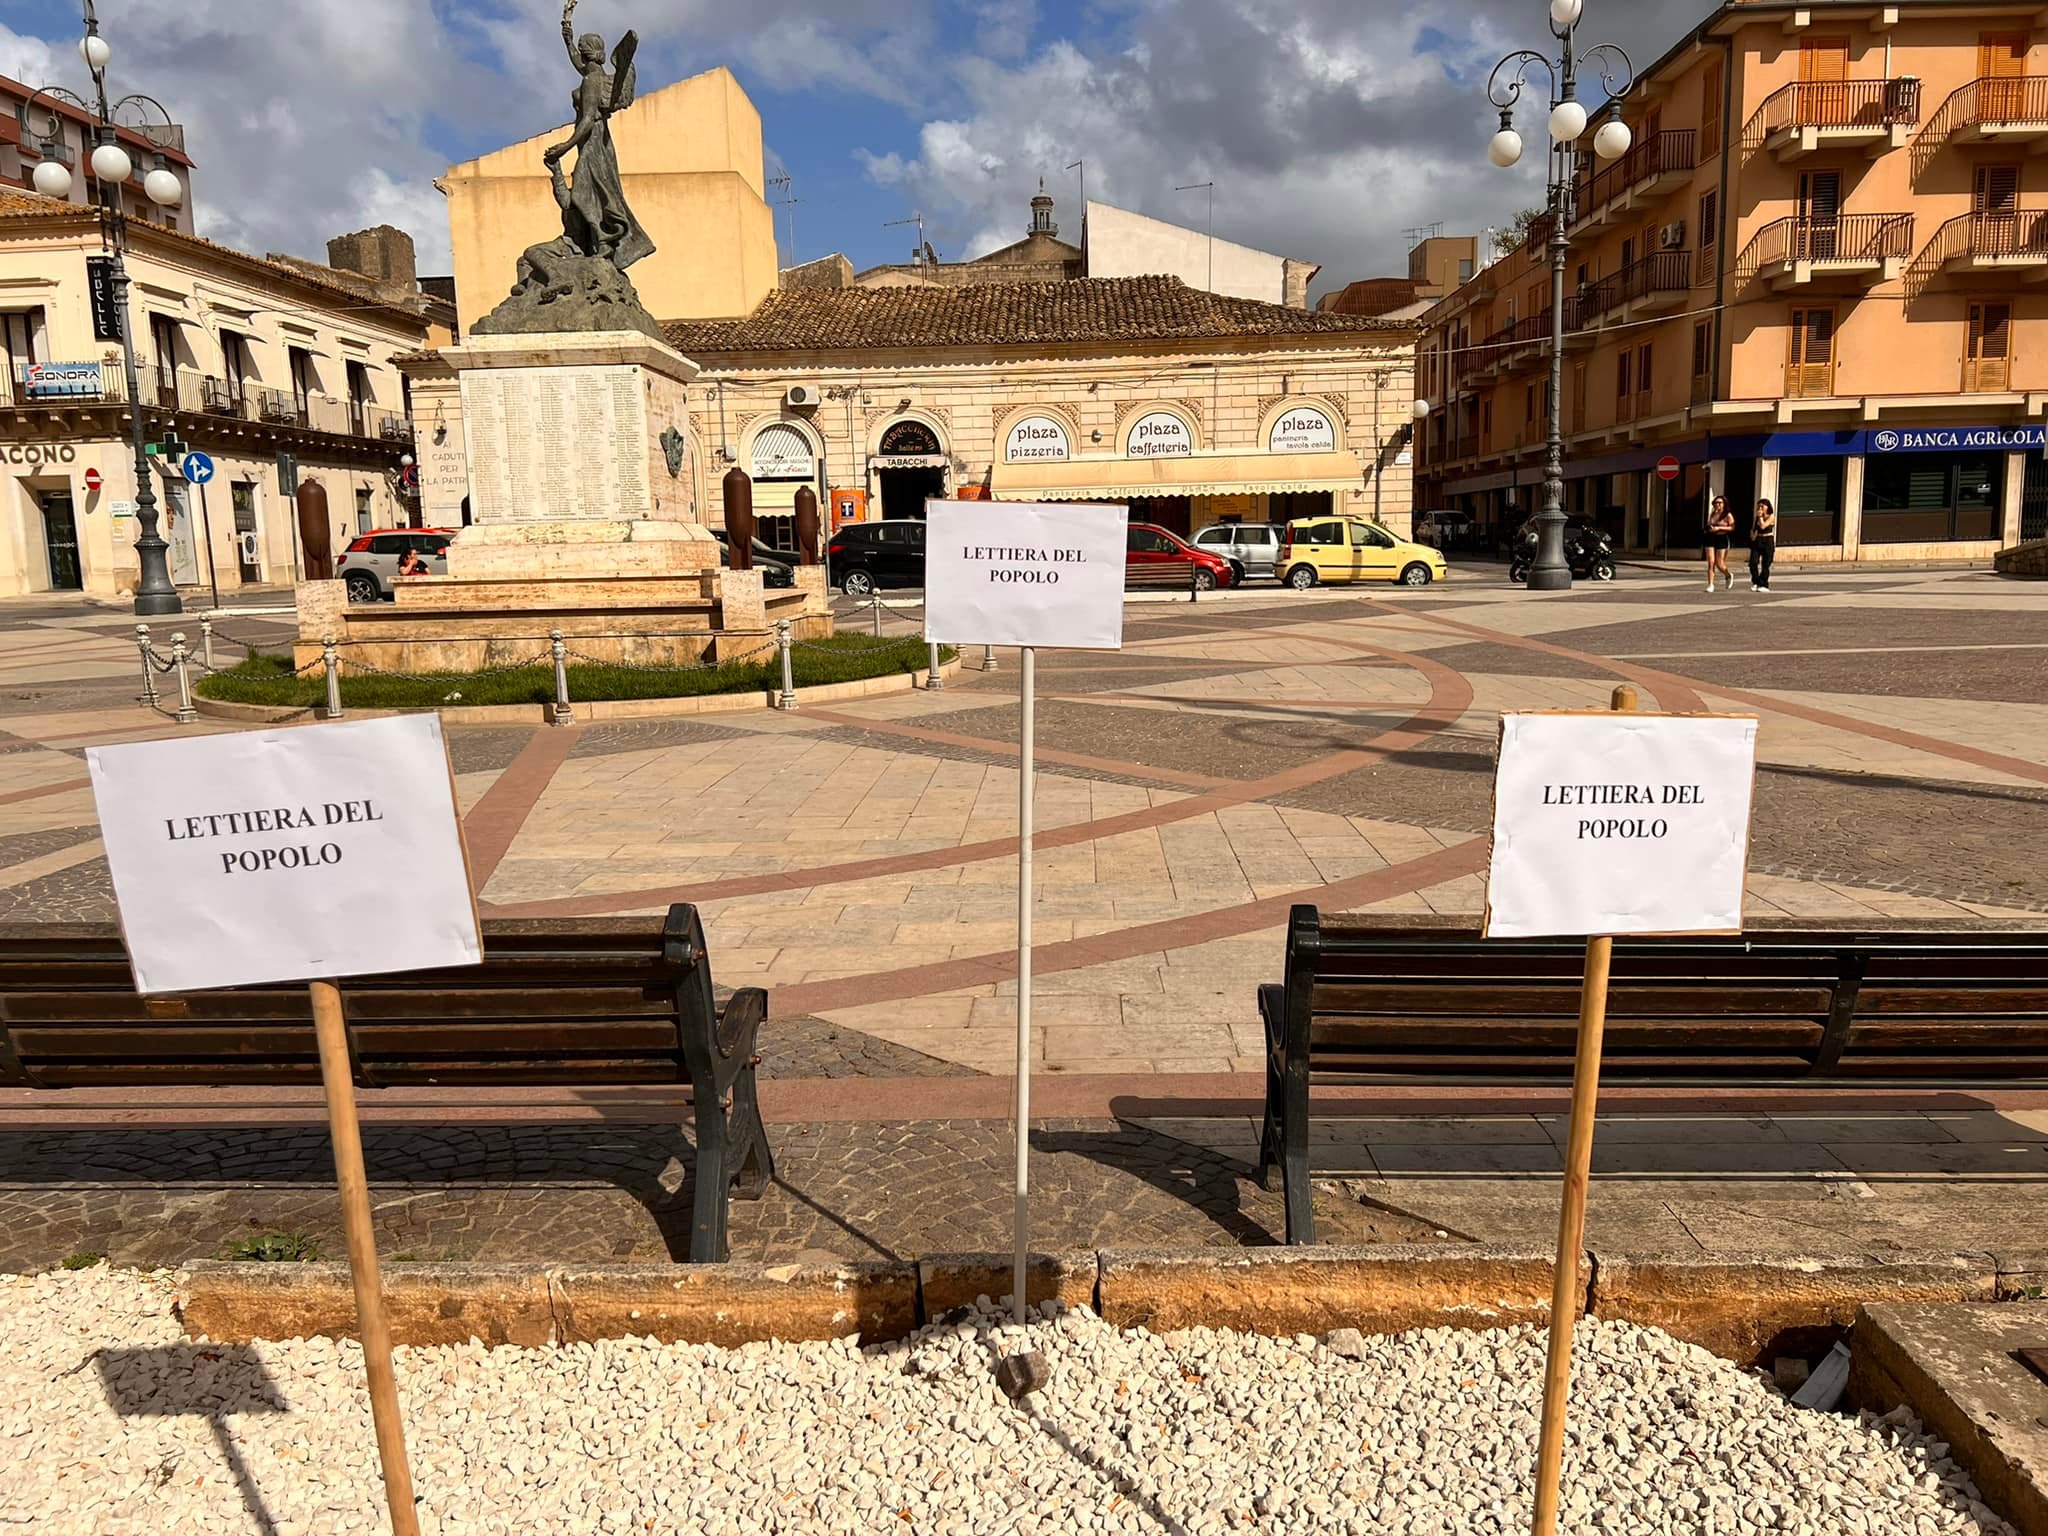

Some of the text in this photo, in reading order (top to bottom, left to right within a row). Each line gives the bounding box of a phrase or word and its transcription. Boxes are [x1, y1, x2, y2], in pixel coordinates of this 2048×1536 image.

[34, 370, 100, 381] SONORA
[1017, 425, 1058, 442] plaza
[1139, 421, 1181, 439] plaza
[1281, 417, 1324, 434] plaza
[1286, 440, 1331, 450] tavola calda
[1903, 432, 1958, 448] BANCA
[1963, 430, 2045, 446] AGRICOLA
[1010, 446, 1064, 460] pizzeria
[1130, 442, 1189, 455] caffetteria
[431, 453, 465, 461] CADUTI
[887, 458, 928, 466] TABACCHI
[439, 464, 458, 473] PER
[426, 477, 439, 486] LA
[963, 546, 1087, 563] LETTIERA DEL
[990, 569, 1059, 584] POPOLO
[1542, 784, 1705, 804] LETTIERA DEL
[164, 799, 384, 841] LETTIERA DEL
[1577, 818, 1668, 839] POPOLO
[221, 842, 343, 874] POPOLO
